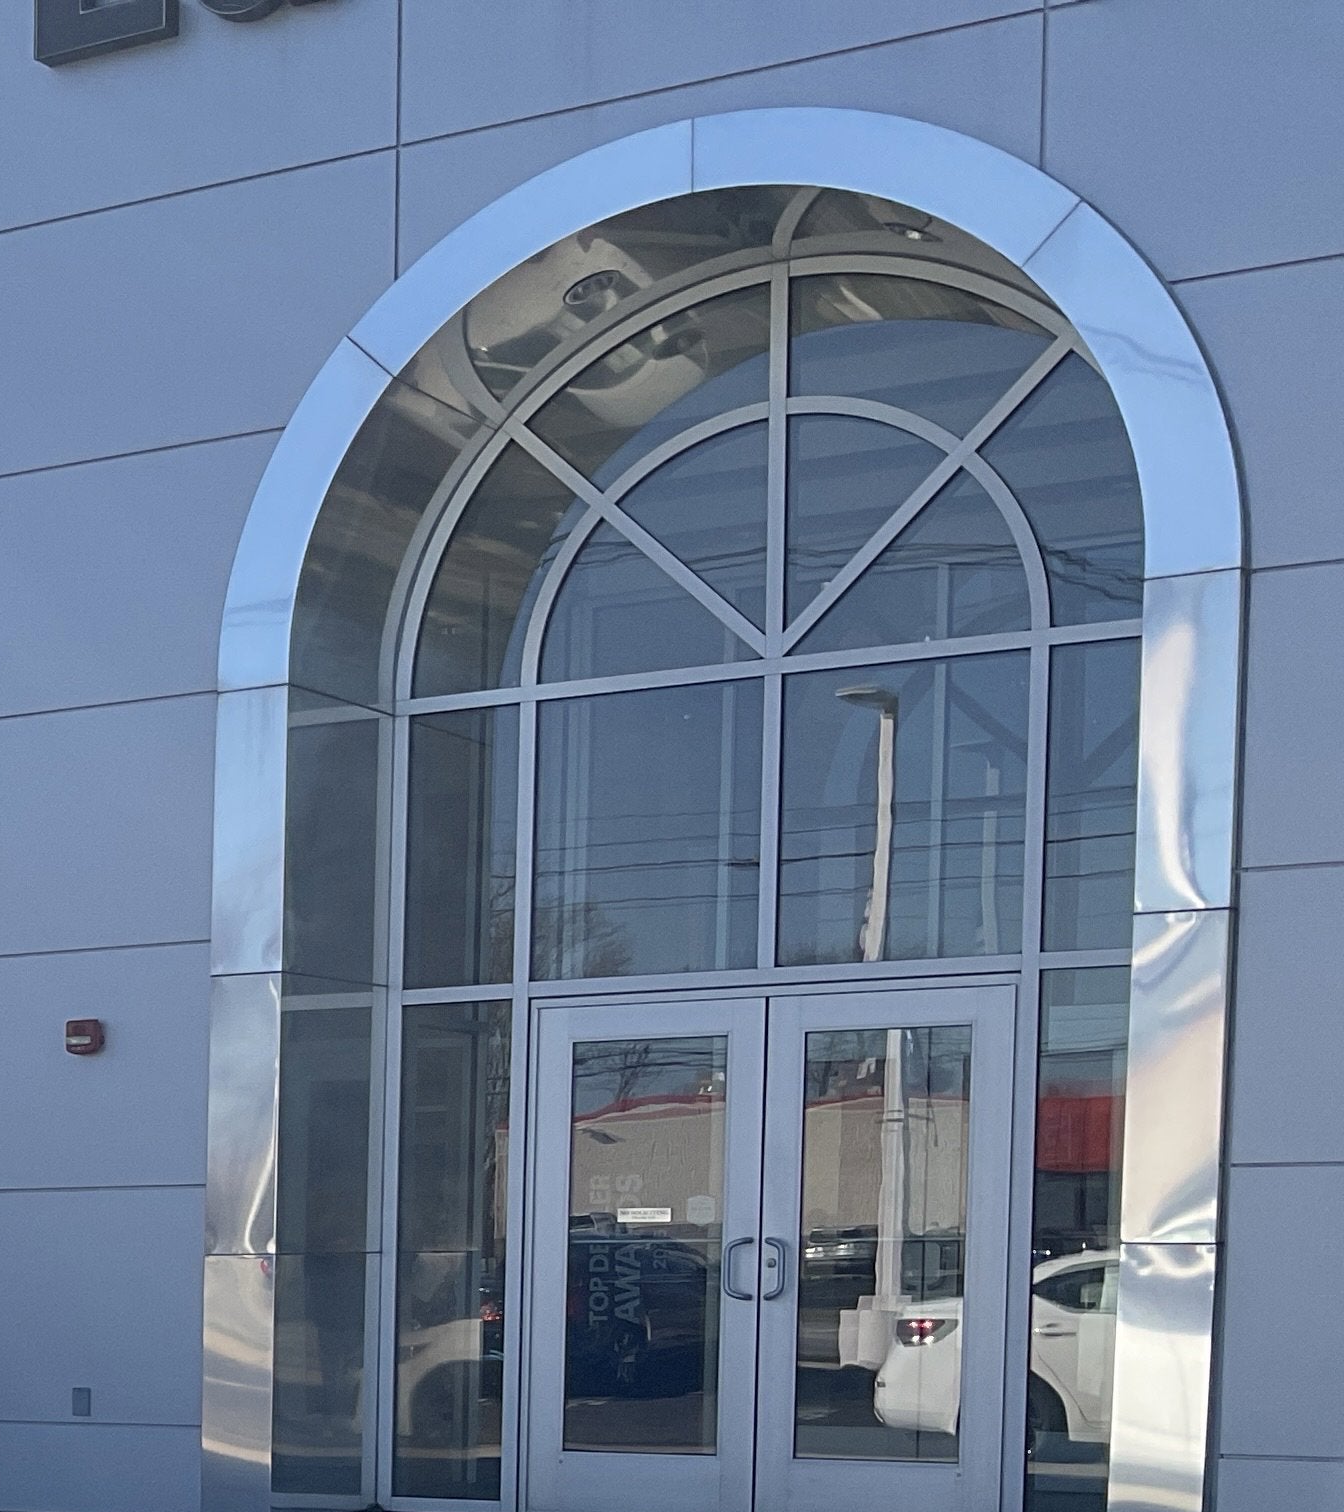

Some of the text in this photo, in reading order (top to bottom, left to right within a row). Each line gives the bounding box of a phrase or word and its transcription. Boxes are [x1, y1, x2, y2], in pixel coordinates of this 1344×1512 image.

[589, 1175, 609, 1328] TOP DEER
[614, 1174, 643, 1324] AWADS
